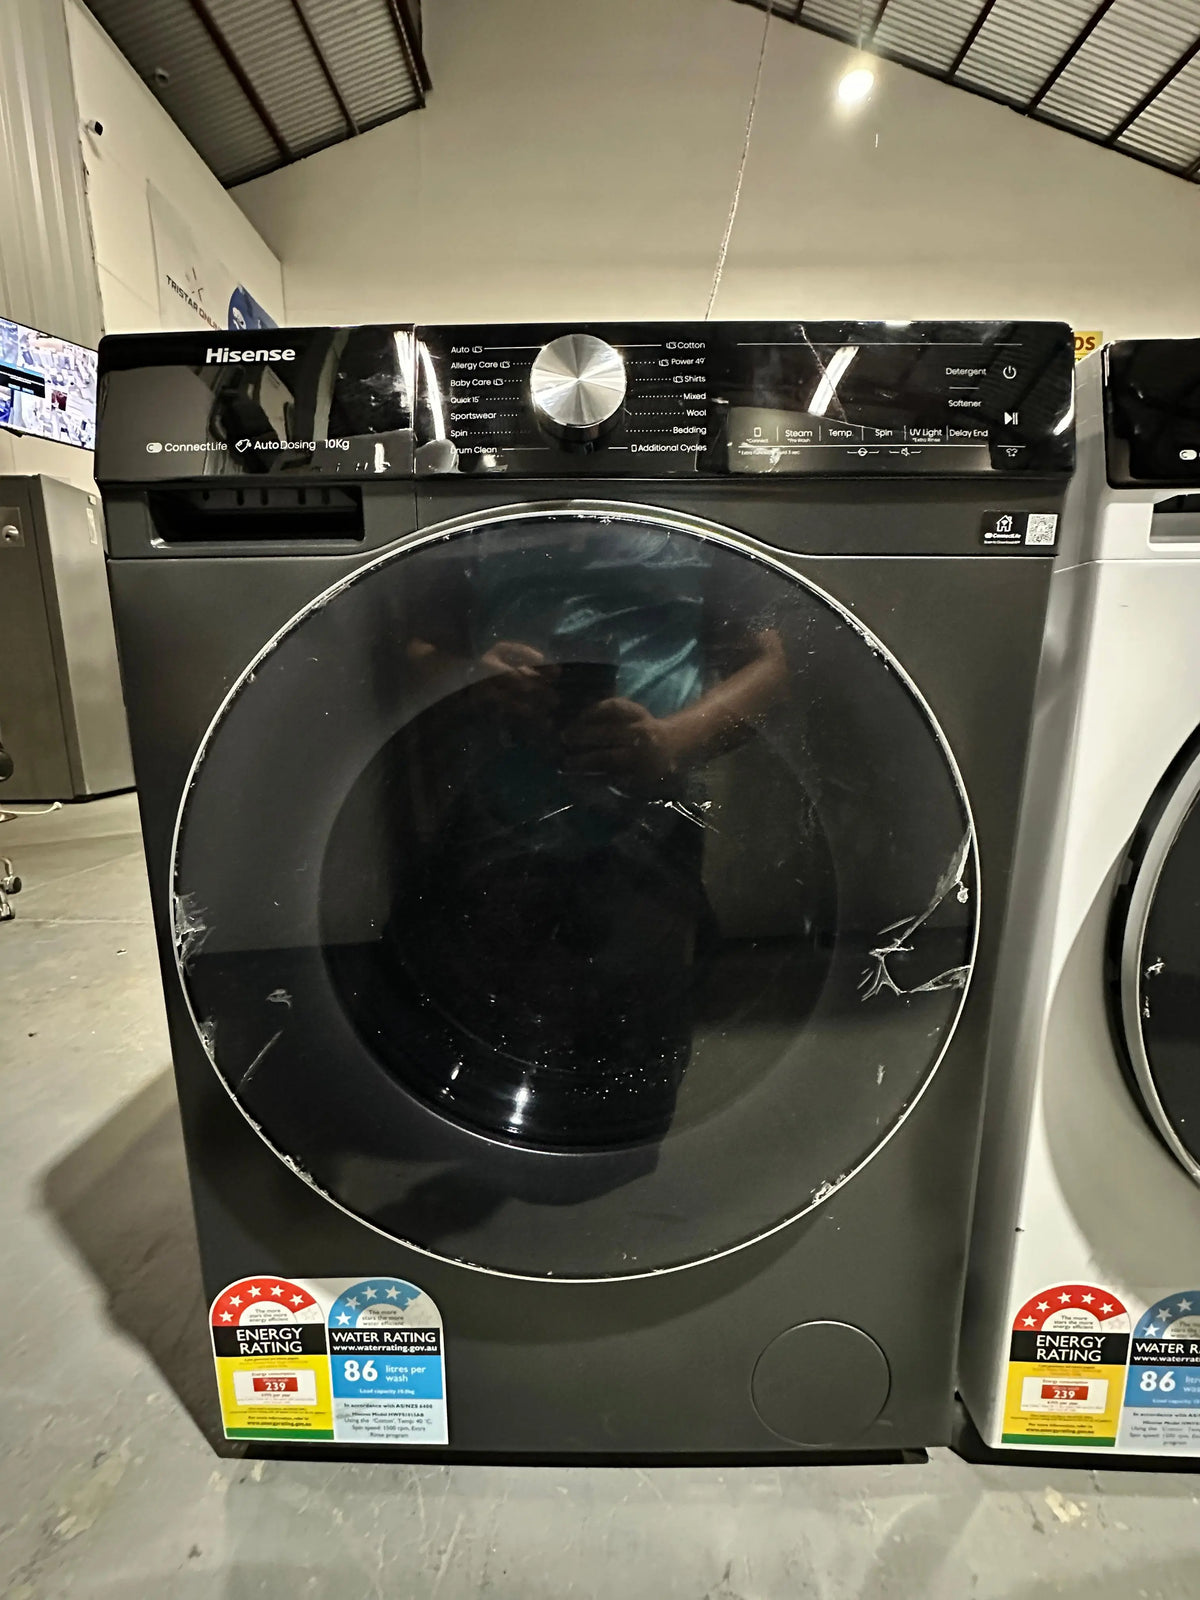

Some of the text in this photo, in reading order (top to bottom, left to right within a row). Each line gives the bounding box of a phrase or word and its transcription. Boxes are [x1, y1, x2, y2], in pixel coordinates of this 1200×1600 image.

[166, 275, 200, 312] TRISTAR
[450, 346, 470, 354] Auto
[205, 348, 296, 364] Hisense
[450, 361, 498, 370] Allergy Care
[945, 367, 987, 377] Detergent
[450, 378, 492, 388] Baby Care
[684, 375, 706, 383] Shirts
[683, 392, 706, 400] Mixed
[948, 399, 982, 408] Softener
[450, 412, 497, 422] Sportswear
[686, 409, 707, 417] Wool
[450, 429, 468, 438] Spin
[673, 426, 707, 435] Bedding
[875, 429, 893, 438] Spin
[922, 428, 943, 438] Light
[949, 429, 988, 438] Delay End
[164, 441, 228, 452] ConnectLife
[254, 440, 316, 451] AutoDosing
[325, 439, 350, 451] 10Kg
[474, 446, 498, 454] Clean
[638, 444, 707, 453] Additional Cycles
[236, 1327, 303, 1342] ENERGY
[332, 1332, 436, 1343] WATER RATING
[1036, 1334, 1106, 1349] ENERGY
[240, 1341, 303, 1354] RATING
[332, 1344, 438, 1353] www.waterrating.gov.au
[1136, 1342, 1184, 1354] WATER
[1037, 1348, 1102, 1362] RATING
[344, 1360, 426, 1382] 86 litres per
[386, 1374, 408, 1382] wash
[1140, 1370, 1176, 1392] 86
[265, 1382, 286, 1391] 239
[1054, 1390, 1076, 1399] 239
